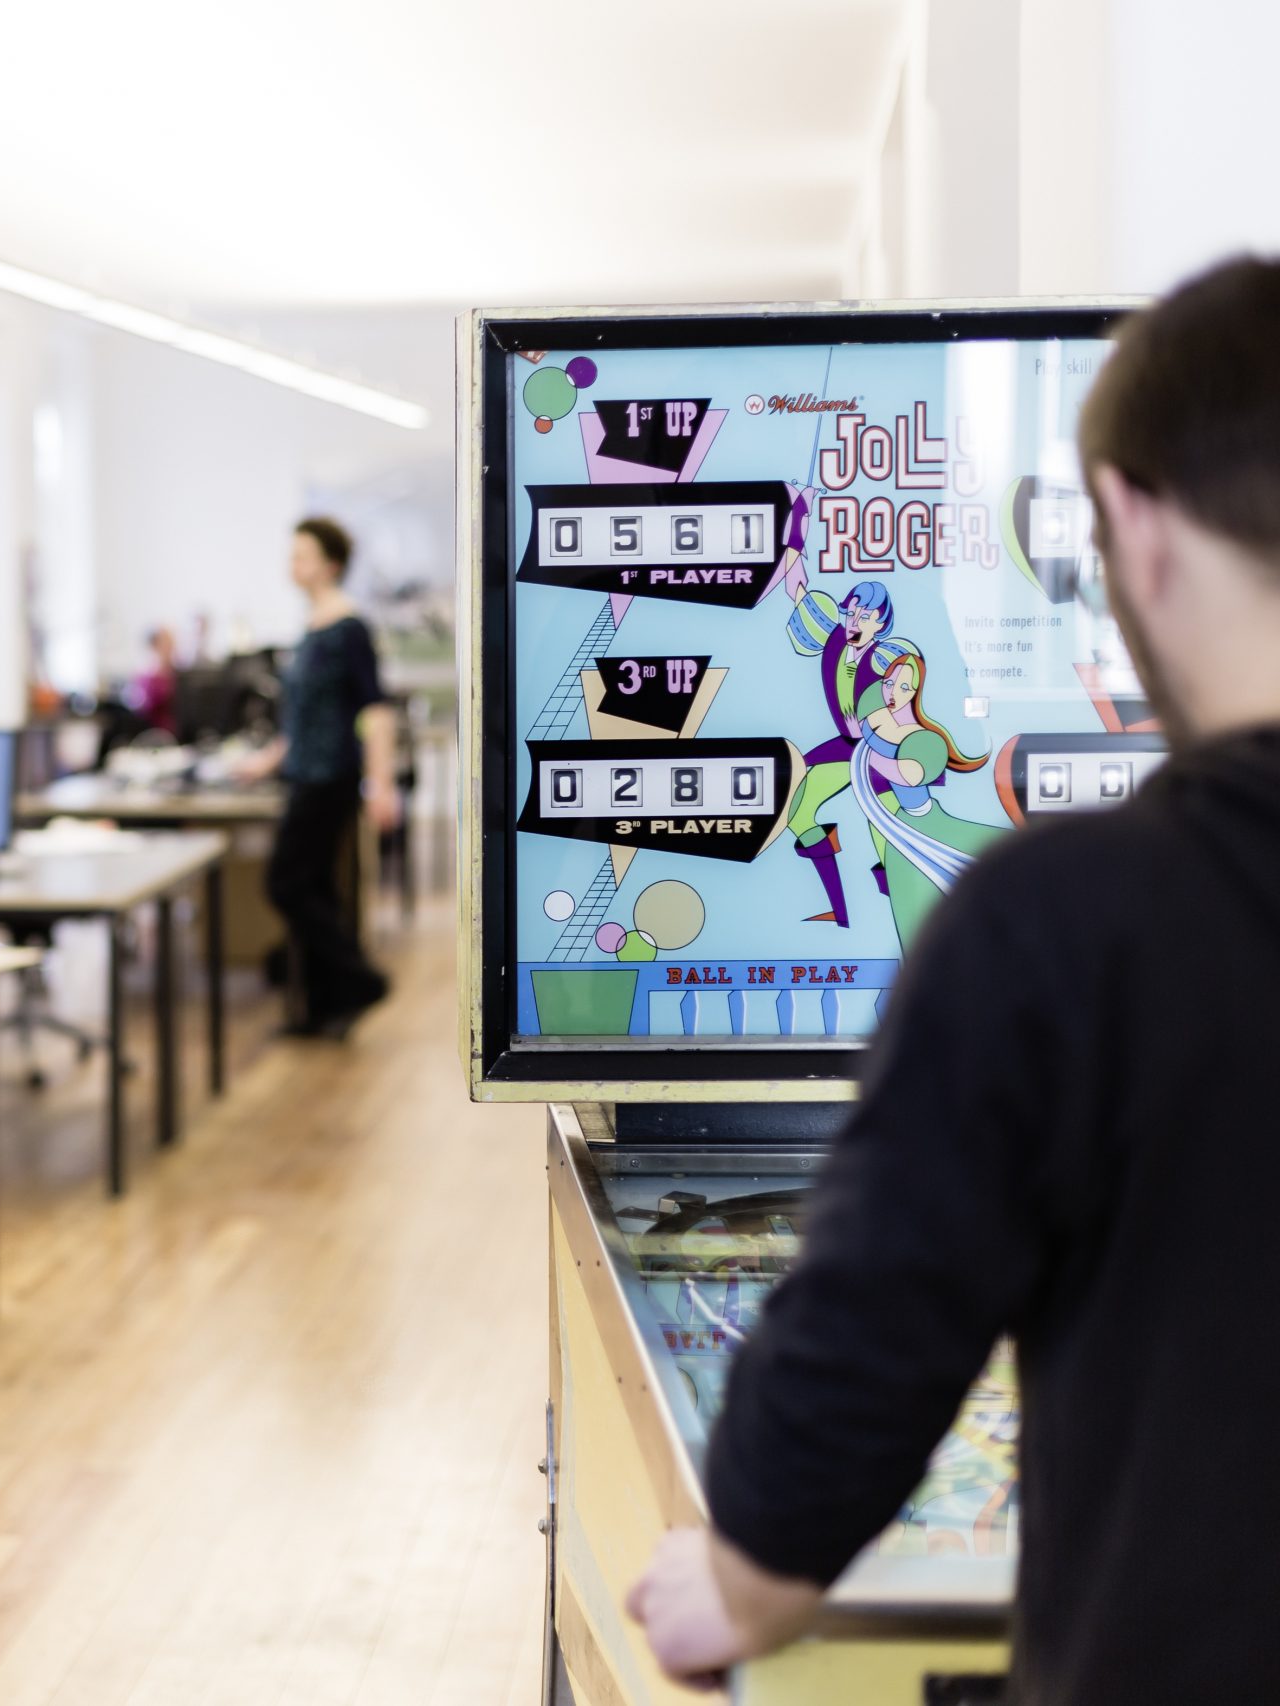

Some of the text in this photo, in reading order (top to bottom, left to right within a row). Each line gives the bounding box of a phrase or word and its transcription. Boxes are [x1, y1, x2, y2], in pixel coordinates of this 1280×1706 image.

[1035, 357, 1092, 380] Ply skill
[767, 393, 859, 415] Williams
[666, 402, 698, 436] UP
[819, 496, 1000, 573] ROGER
[650, 569, 752, 584] PLAYER
[964, 616, 1062, 630] Invite competition
[964, 640, 1033, 653] It's more fun
[618, 659, 698, 695] 3RD UP
[964, 666, 976, 678] to
[615, 819, 752, 834] 3RD PLAYER
[666, 965, 859, 985] BALL IN PLAY
